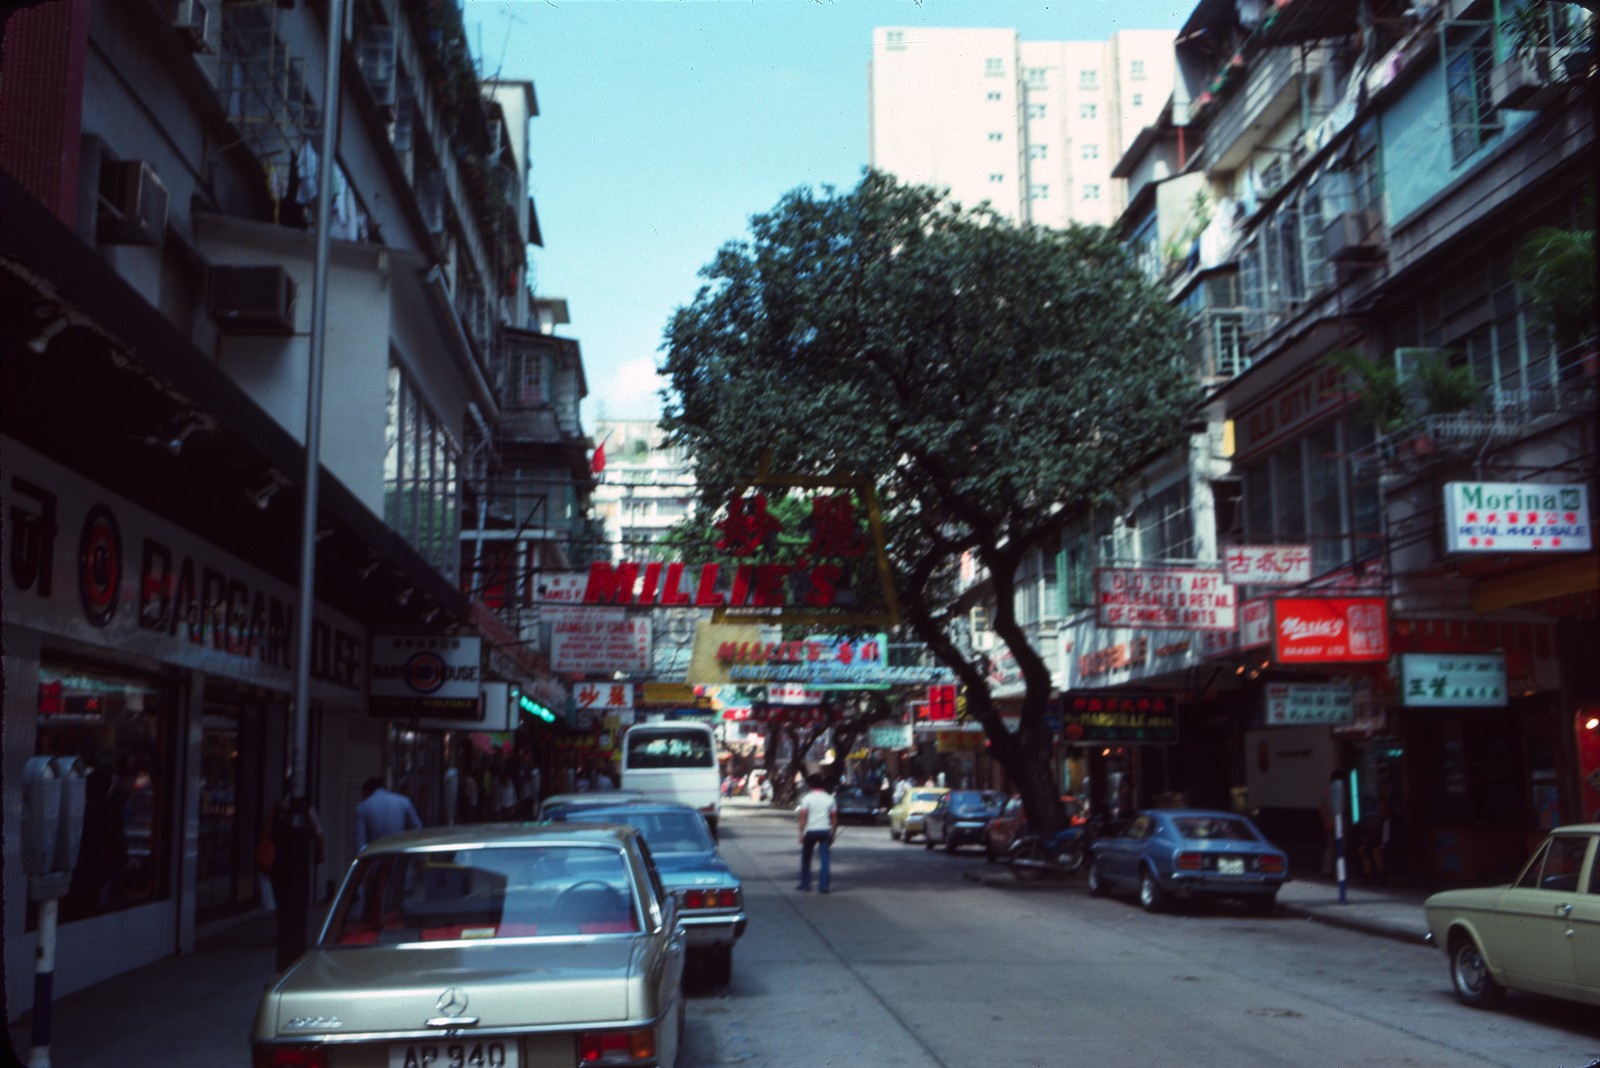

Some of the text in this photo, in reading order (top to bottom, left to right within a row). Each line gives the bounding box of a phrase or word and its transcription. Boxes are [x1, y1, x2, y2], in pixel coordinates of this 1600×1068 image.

[1462, 486, 1556, 510] Morina
[583, 559, 843, 607] MILLIE'S
[1113, 574, 1219, 591] OLD CITY ART
[1102, 592, 1175, 607] WHOLESALE
[1189, 593, 1229, 608] RETAIL
[139, 537, 363, 694] BARGAIN OUSE
[1107, 608, 1123, 622] OF
[1184, 609, 1217, 625] ARTS
[555, 621, 592, 634] JAMES
[403, 1043, 507, 1068] AP 940
